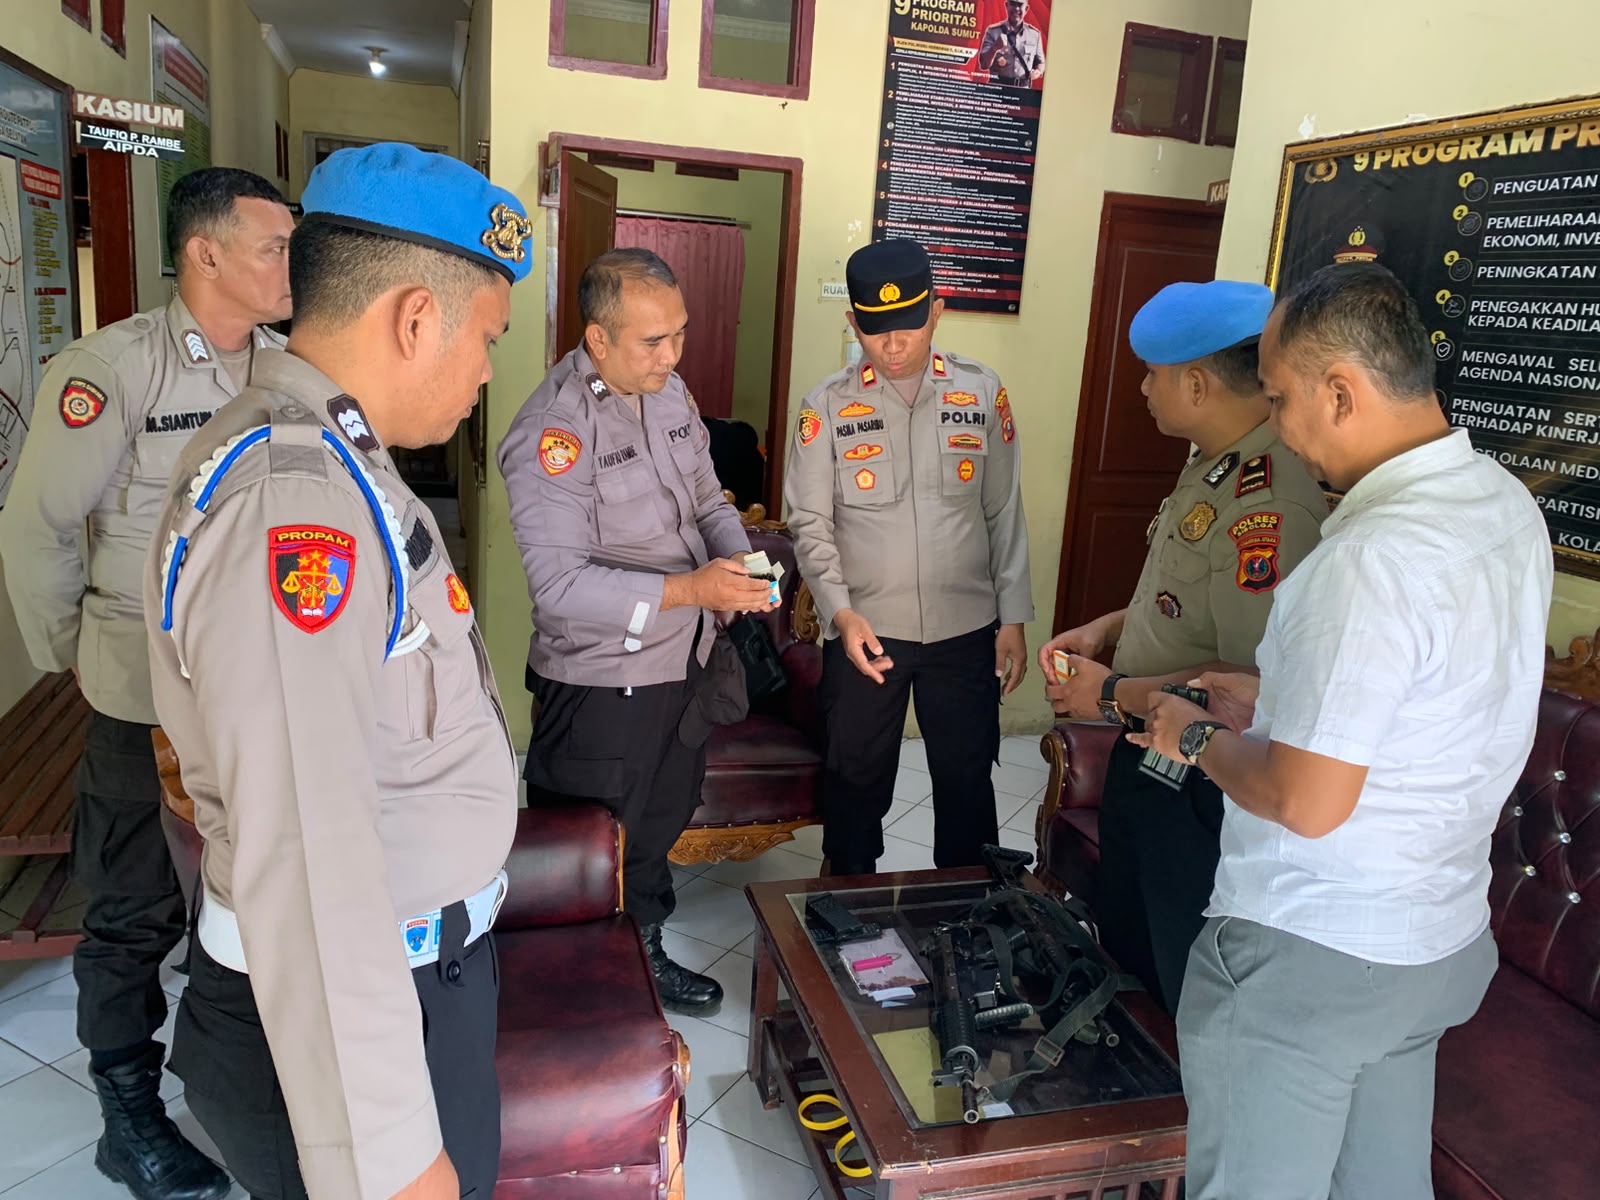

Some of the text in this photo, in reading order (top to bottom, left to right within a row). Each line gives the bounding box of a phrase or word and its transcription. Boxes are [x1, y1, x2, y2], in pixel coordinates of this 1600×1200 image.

[912, 0, 975, 14] PROGRAM
[912, 8, 976, 28] PRIORITAS
[911, 22, 980, 39] KAPOLDA SUMUT
[77, 93, 184, 128] KASIUM
[88, 125, 181, 149] TAUFIQ P. RAMBE
[884, 139, 889, 147] 3
[103, 141, 159, 158] AIPDA
[1354, 152, 1369, 172] 9
[1373, 128, 1548, 170] PROGRAM
[1464, 175, 1469, 183] 1
[1493, 175, 1598, 195] PENGUATAN
[1456, 209, 1464, 217] 2
[1486, 212, 1600, 229] PEMELIHARAA
[1483, 234, 1560, 249] EKONOMI,
[1477, 265, 1597, 279] PENINGKATAN
[1470, 300, 1578, 315] PENEGAKKAN
[1468, 315, 1528, 329] KEPADA
[1434, 333, 1441, 342] 5
[1462, 350, 1600, 372] MENGAWAL SEL
[1458, 366, 1523, 383] AGENDA
[941, 412, 985, 425] POLRI
[1452, 398, 1600, 427] PENGUATAN SER
[668, 424, 690, 443] POL
[1450, 413, 1600, 445] TERHADAP KINERJ
[1560, 462, 1600, 480] MED
[1233, 515, 1277, 535] POLRES
[1237, 523, 1273, 536] SIBOLGA
[278, 531, 349, 547] PROPAM
